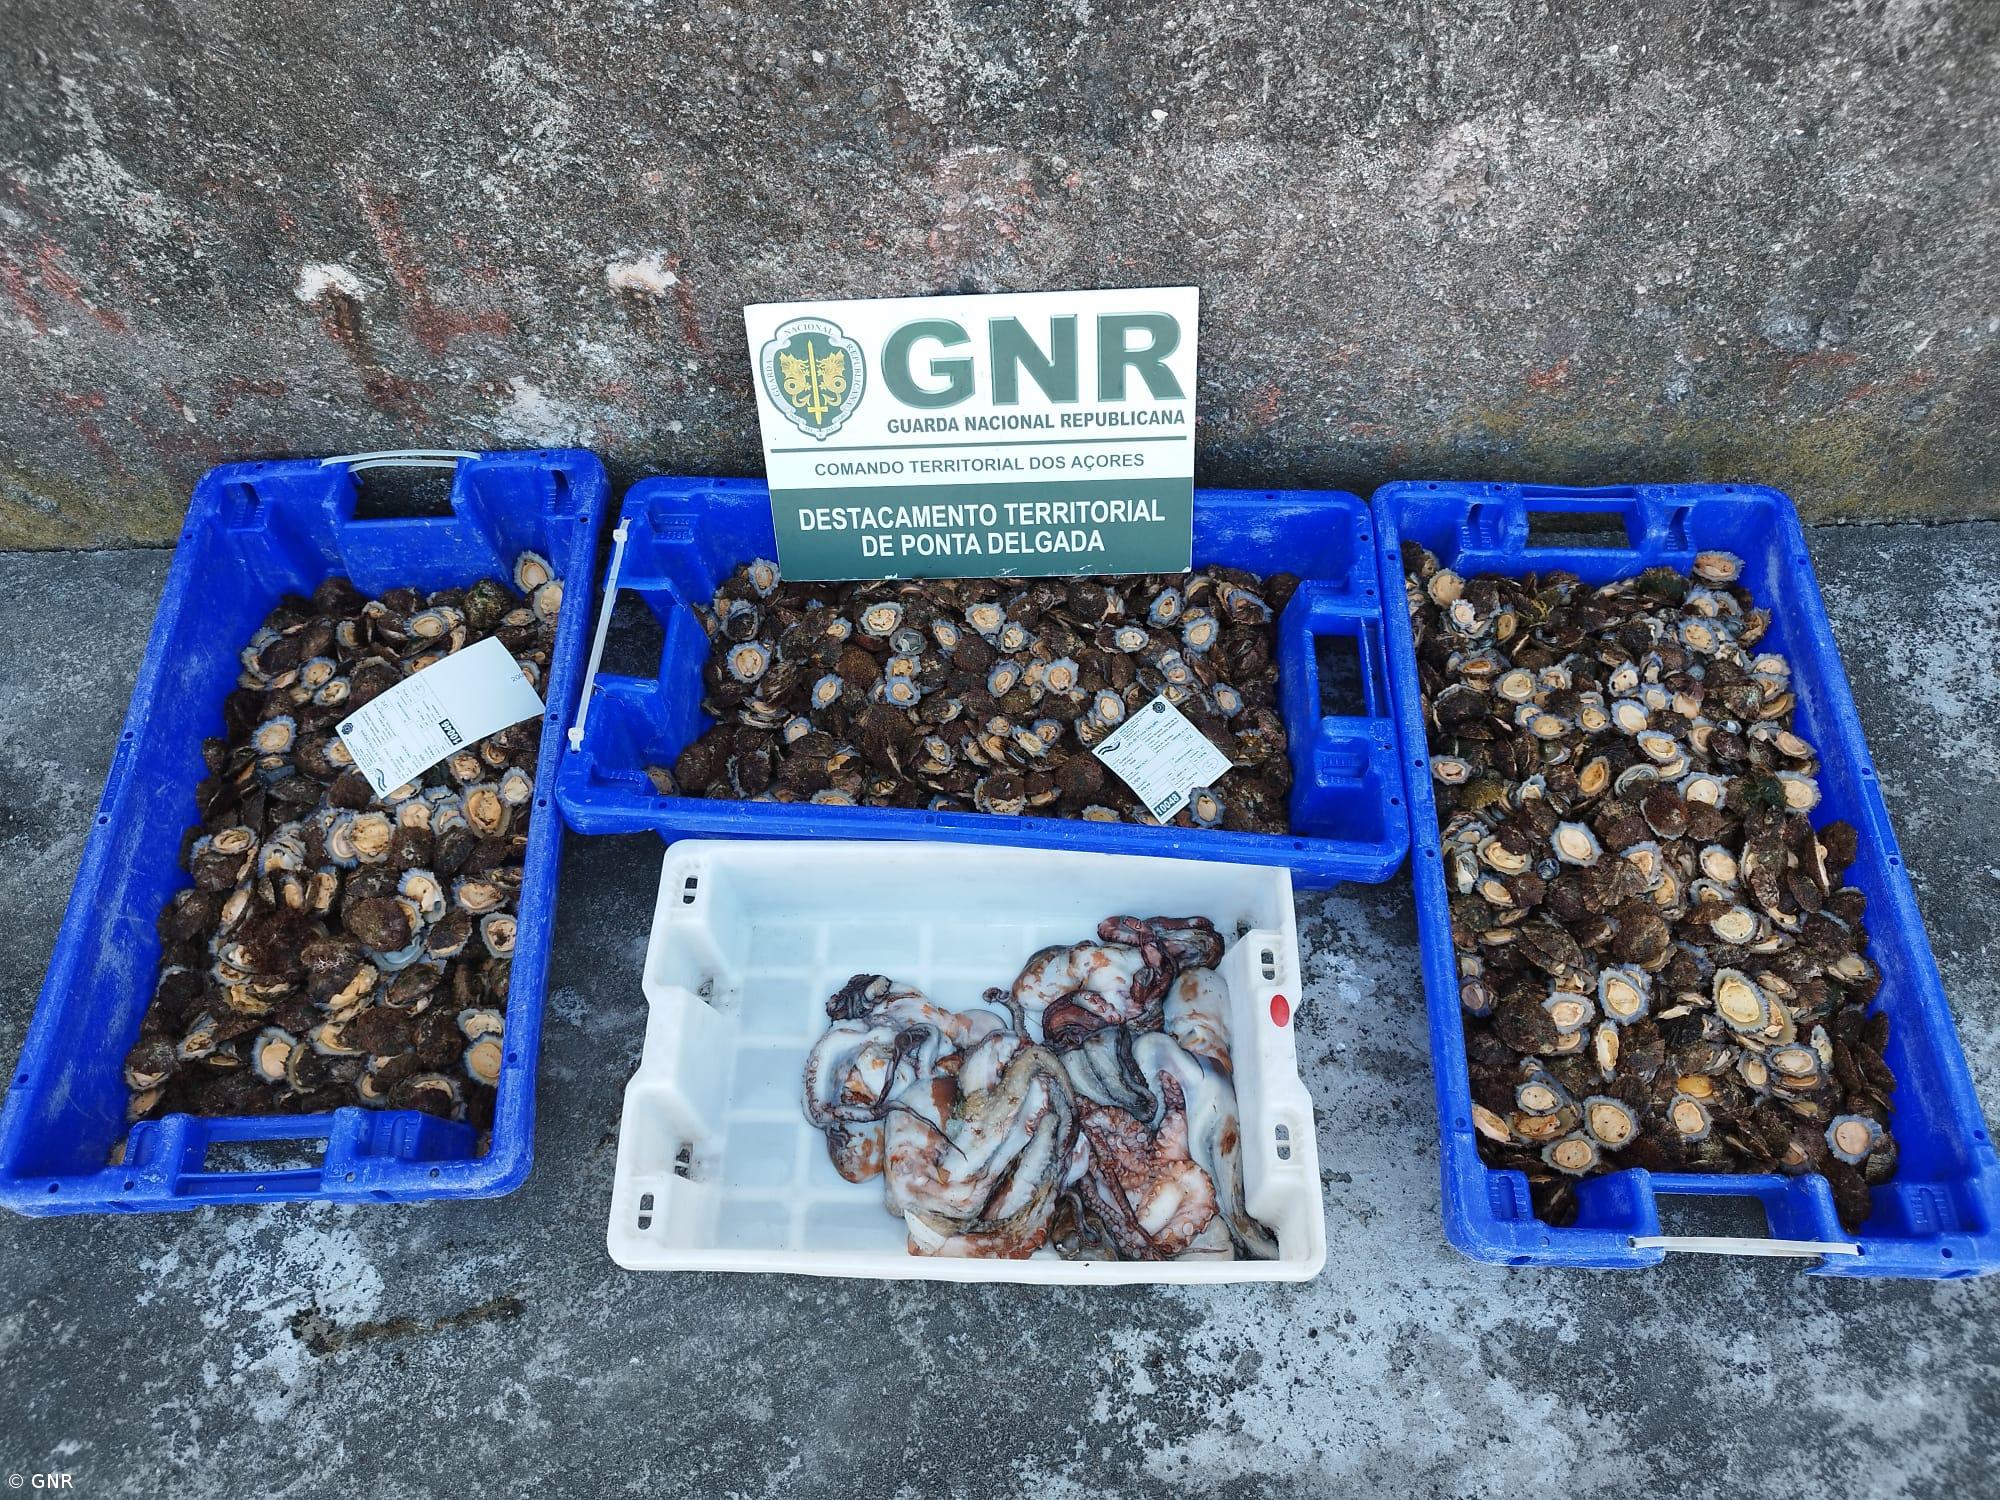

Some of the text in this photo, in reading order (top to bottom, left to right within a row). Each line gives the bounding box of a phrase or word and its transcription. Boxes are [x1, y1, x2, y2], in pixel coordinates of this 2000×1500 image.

[784, 323, 834, 337] NACIONAL
[880, 311, 1187, 409] GNR
[887, 410, 1185, 434] GUARDA NACIONAL REPUBLICANA
[814, 453, 1145, 477] COMANDO TERRITORIAL DOS AÇORES
[798, 499, 1165, 532] DESTACAMENTO TERRITORIAL
[861, 529, 1105, 558] DE PONTA DELGADA
[1155, 793, 1180, 815] 10048
